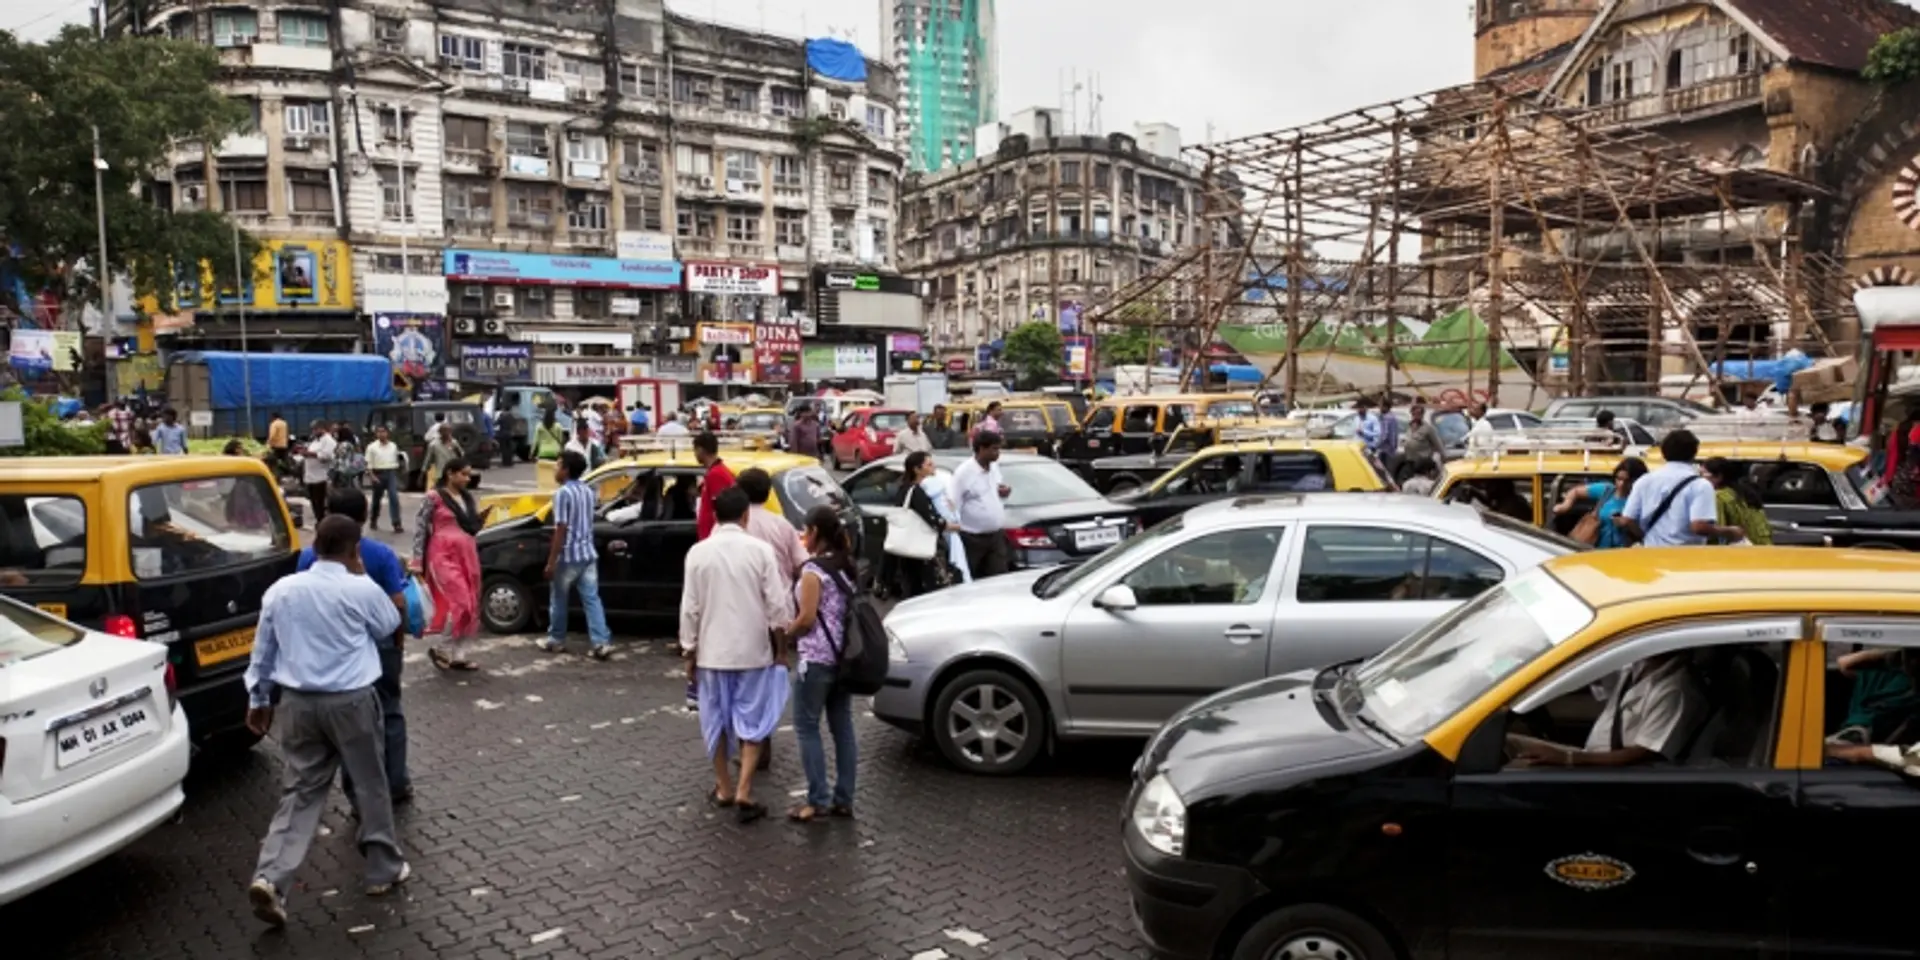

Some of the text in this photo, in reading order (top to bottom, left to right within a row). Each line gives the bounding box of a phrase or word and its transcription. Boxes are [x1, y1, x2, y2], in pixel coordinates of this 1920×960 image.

[695, 265, 770, 280] PARTY SHOP
[756, 326, 800, 341] DINA
[465, 357, 529, 370] CHIKAN
[567, 366, 626, 379] BADSHAH
